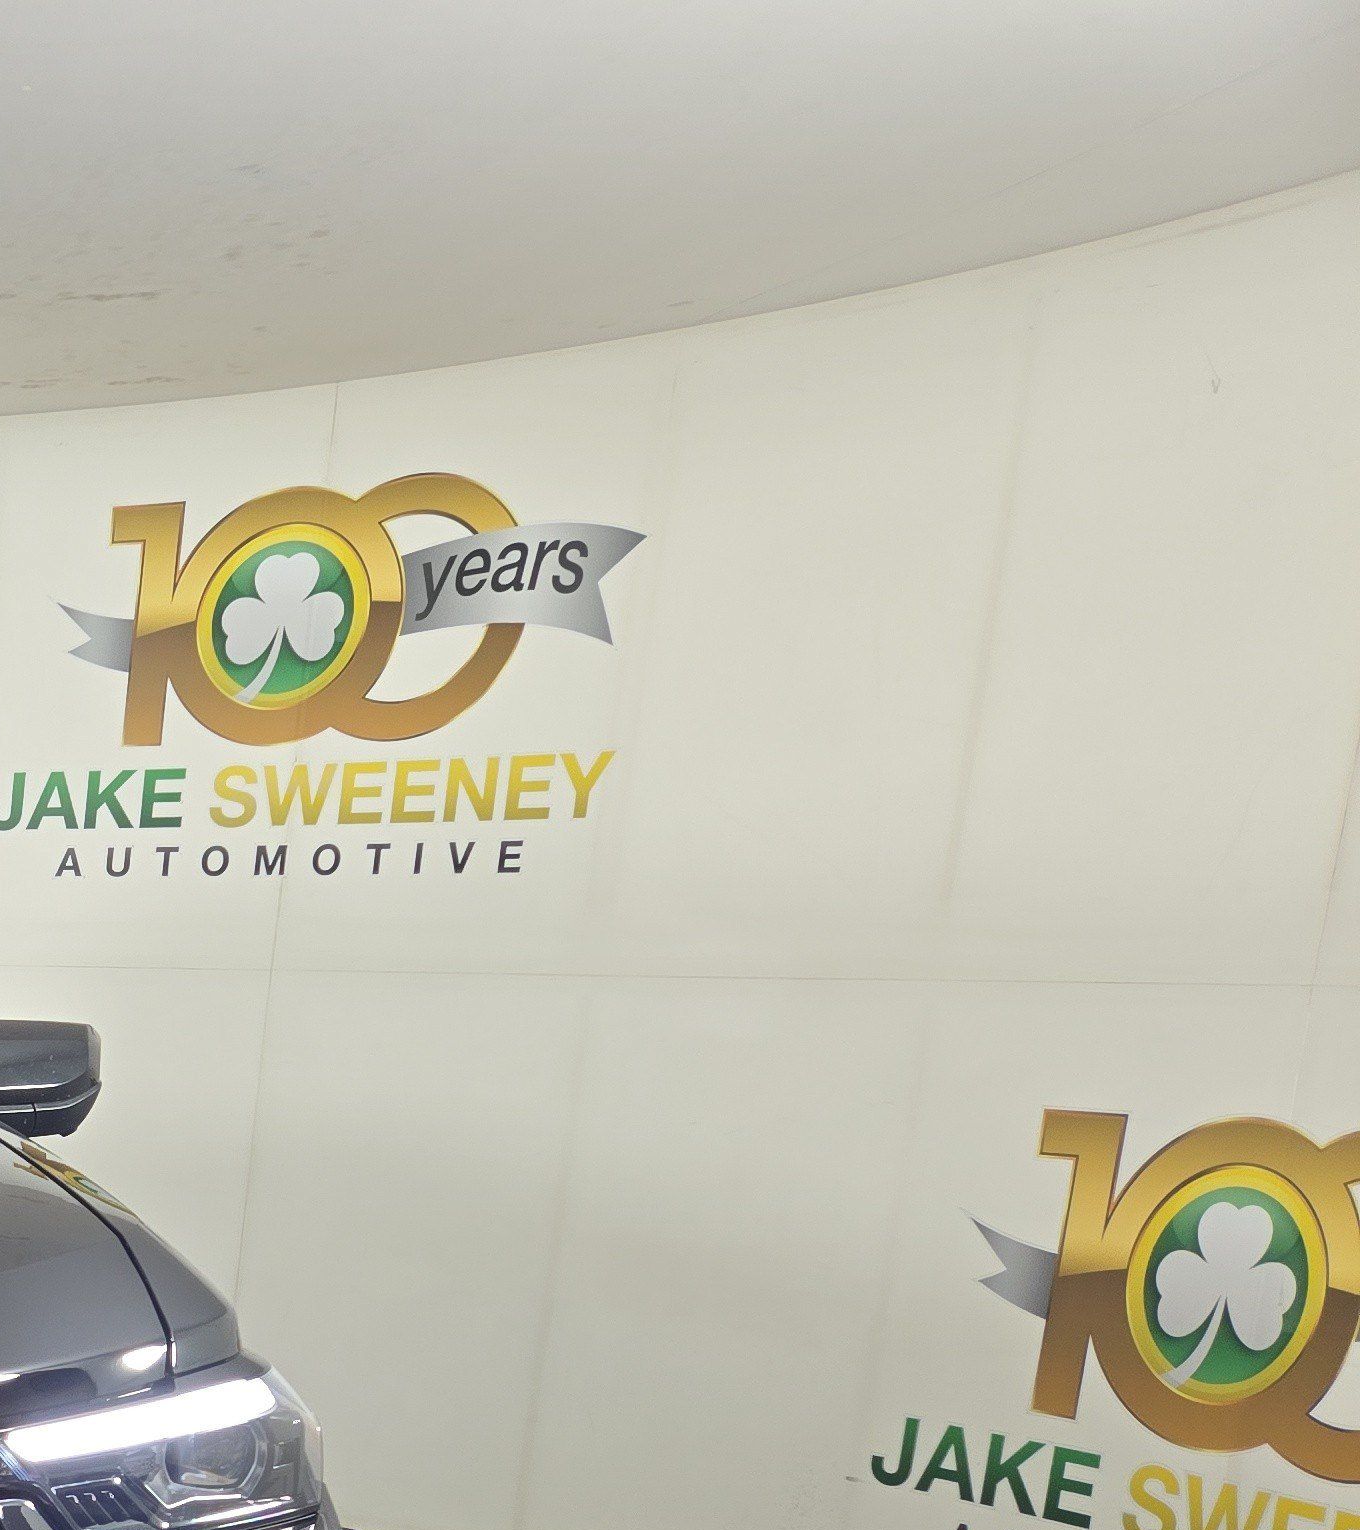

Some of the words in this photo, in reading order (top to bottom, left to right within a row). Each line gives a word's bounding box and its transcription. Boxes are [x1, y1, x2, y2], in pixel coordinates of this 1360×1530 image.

[415, 538, 589, 622] years
[209, 751, 616, 828] SWEENEY
[55, 840, 524, 877] AUTOMOTIVE
[1031, 1108, 1360, 1485] 10
[871, 1417, 1102, 1530] JAKE
